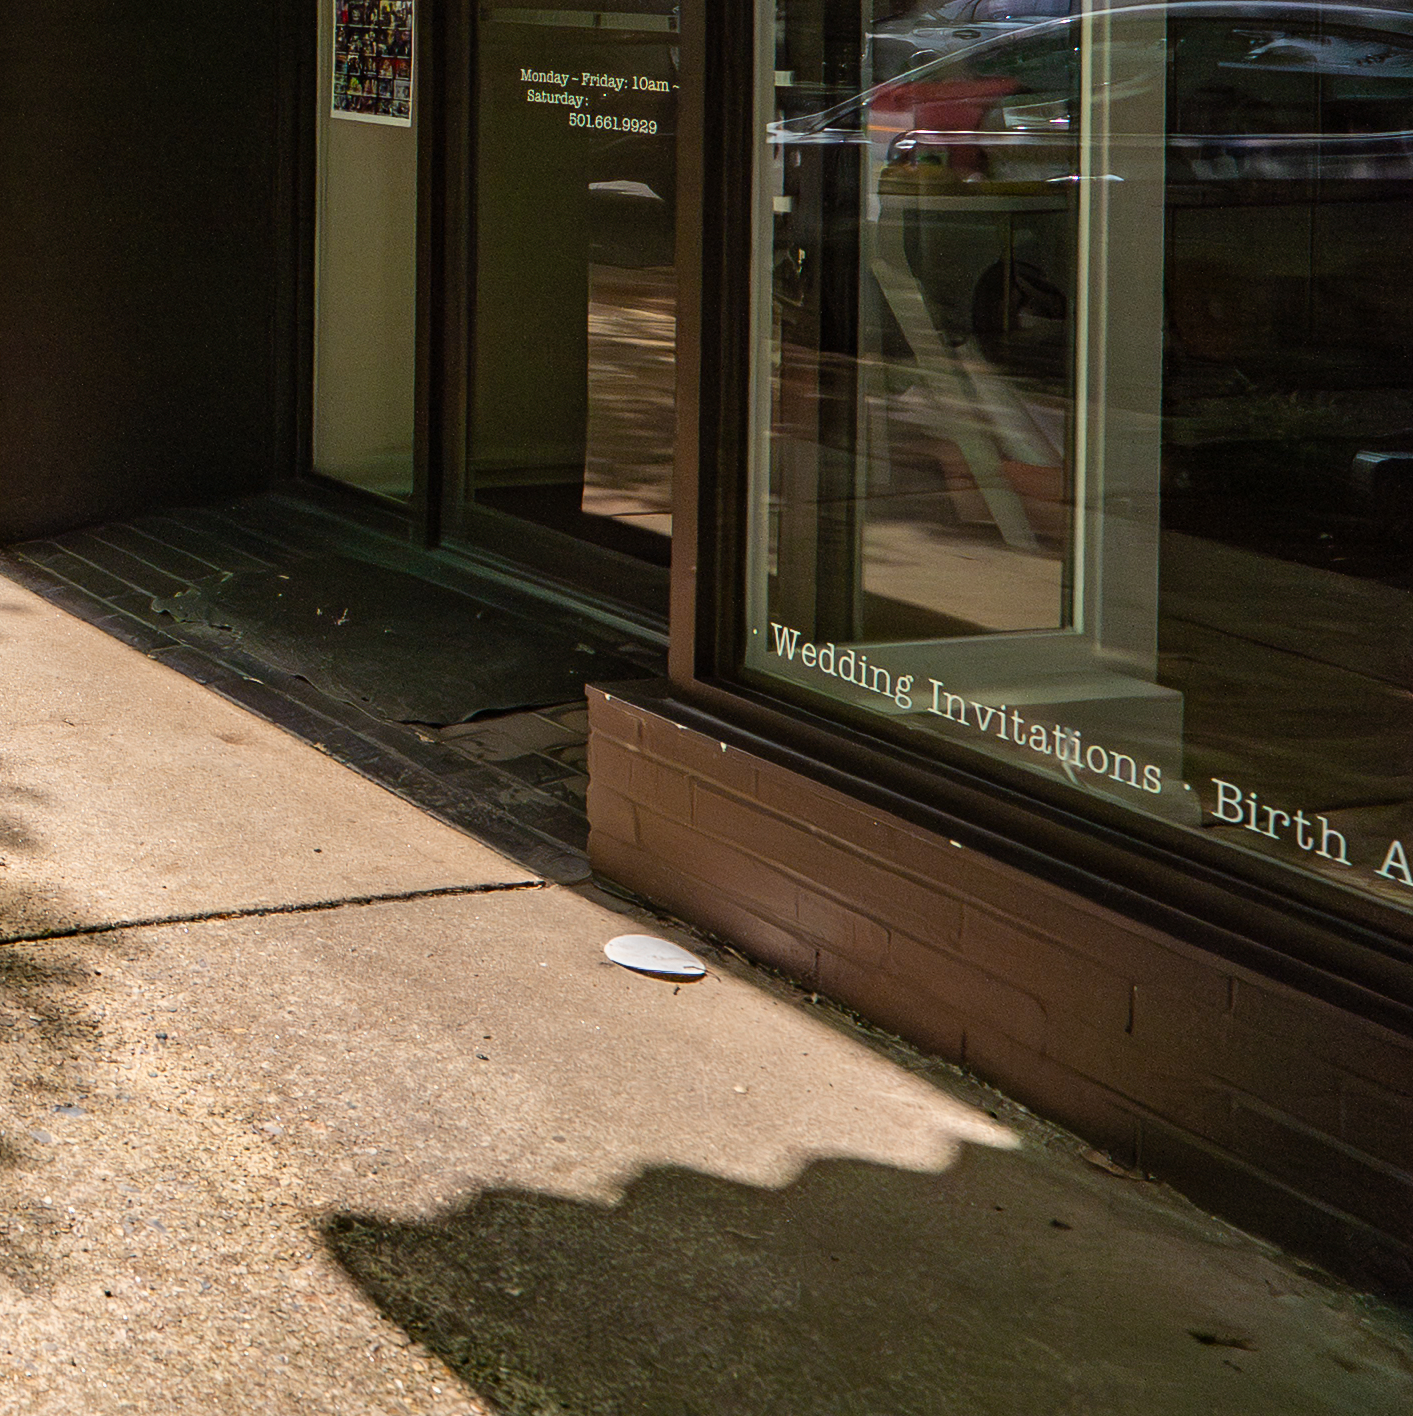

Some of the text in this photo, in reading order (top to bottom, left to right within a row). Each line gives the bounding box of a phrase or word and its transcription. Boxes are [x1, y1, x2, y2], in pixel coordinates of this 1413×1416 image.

[520, 68, 570, 88] Monday
[581, 72, 629, 92] Friday:
[632, 75, 670, 92] 10am
[568, 112, 658, 135] 501.661.9929
[770, 622, 914, 710] Wedding
[927, 678, 1163, 794] Invitations
[1209, 777, 1353, 867] Birth
